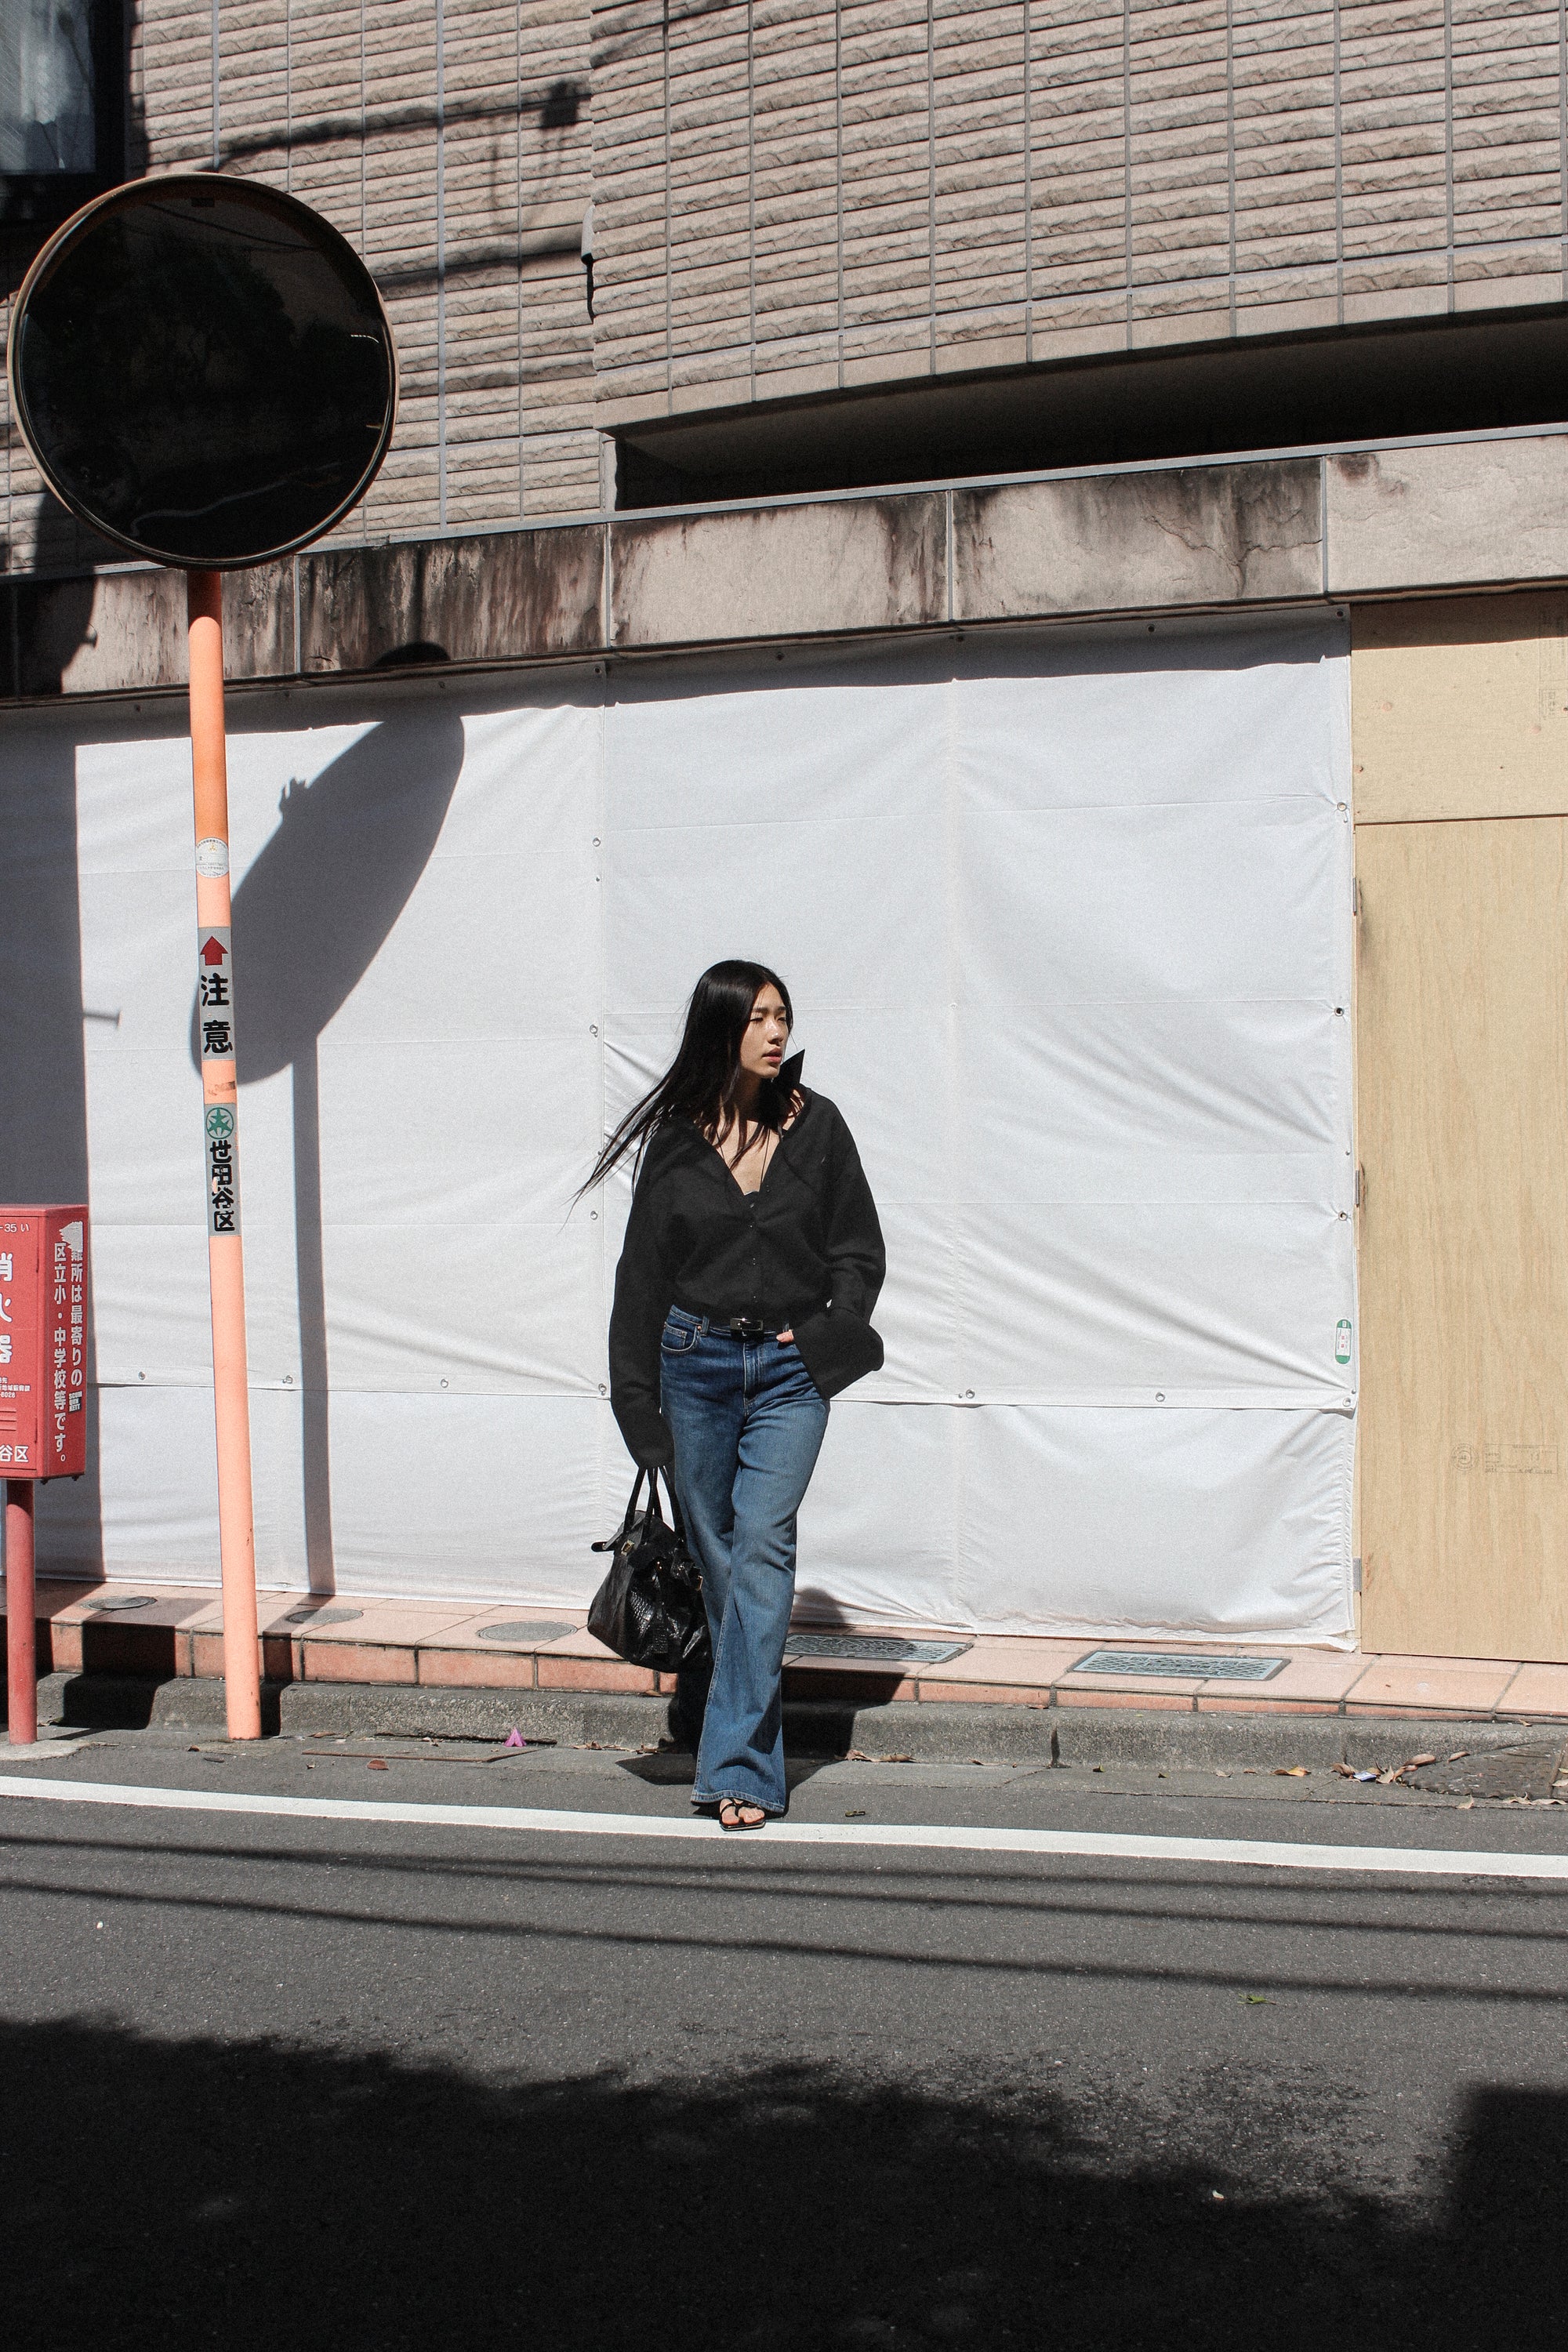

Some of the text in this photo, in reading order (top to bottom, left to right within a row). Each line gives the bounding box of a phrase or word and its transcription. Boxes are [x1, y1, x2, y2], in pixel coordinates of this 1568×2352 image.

[201, 973, 233, 1053] 注意
[210, 1140, 235, 1232] 世田谷区
